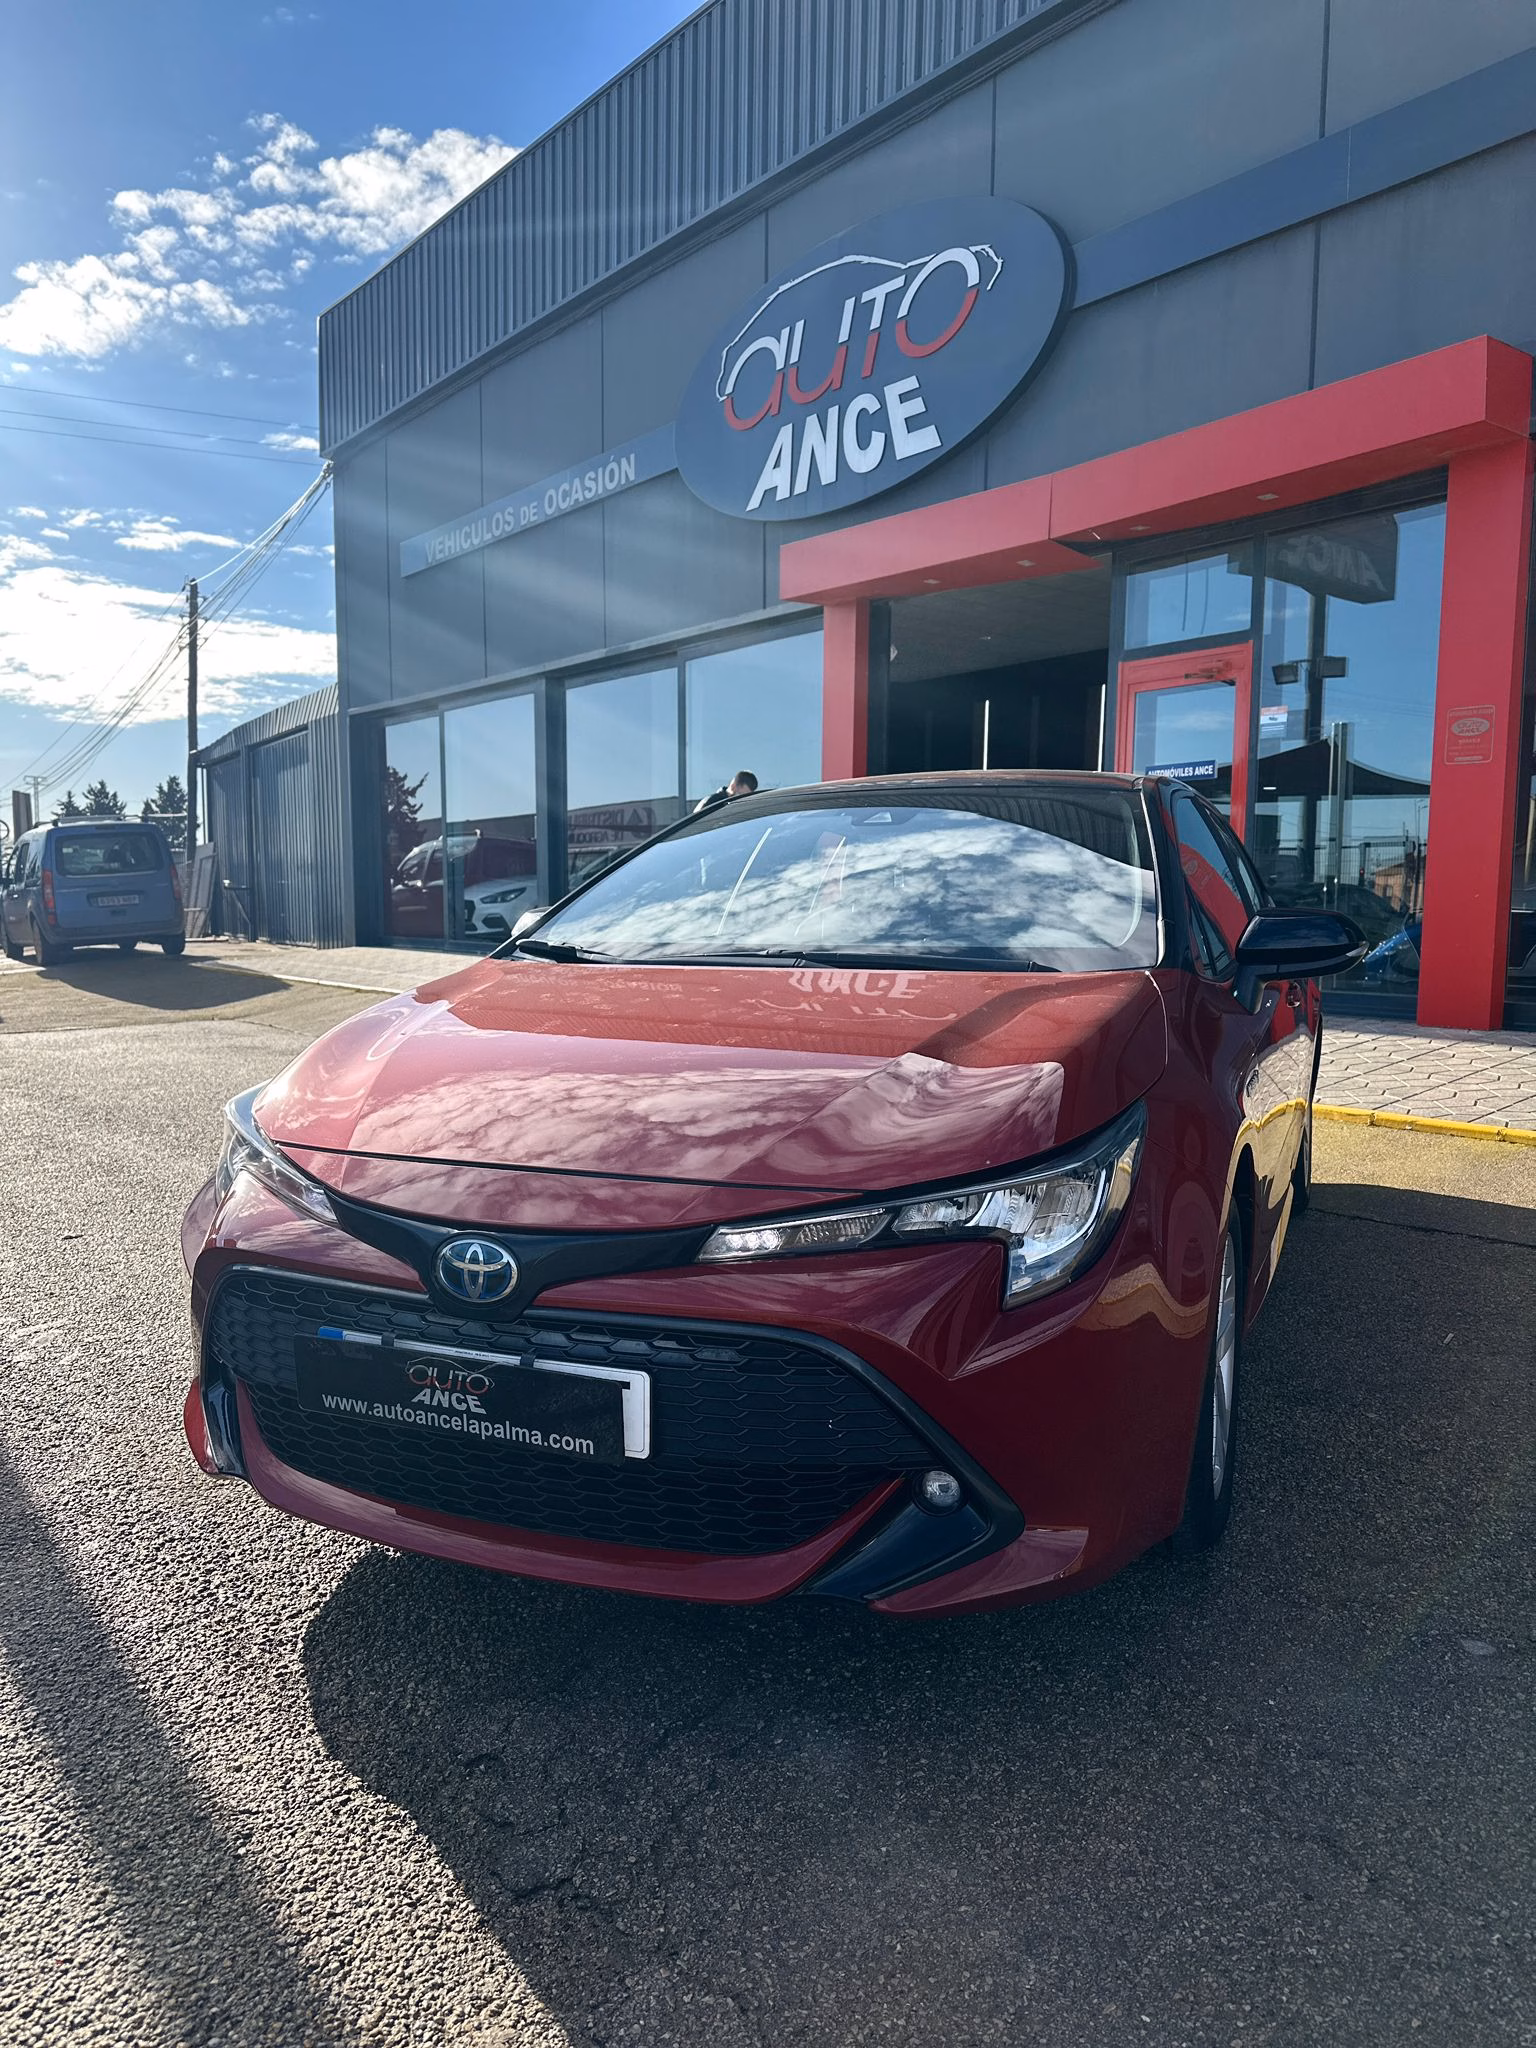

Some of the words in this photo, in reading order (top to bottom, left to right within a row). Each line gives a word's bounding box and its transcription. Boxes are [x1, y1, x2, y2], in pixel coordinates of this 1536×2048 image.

[745, 375, 942, 511] ANCE
[424, 507, 514, 563] VEHICULOS
[520, 501, 538, 526] DE
[544, 453, 635, 516] OCASIÓN
[1194, 765, 1213, 776] ANCE
[322, 1394, 594, 1455] www.autoancelapalma.com
[411, 1387, 487, 1414] ANCE
